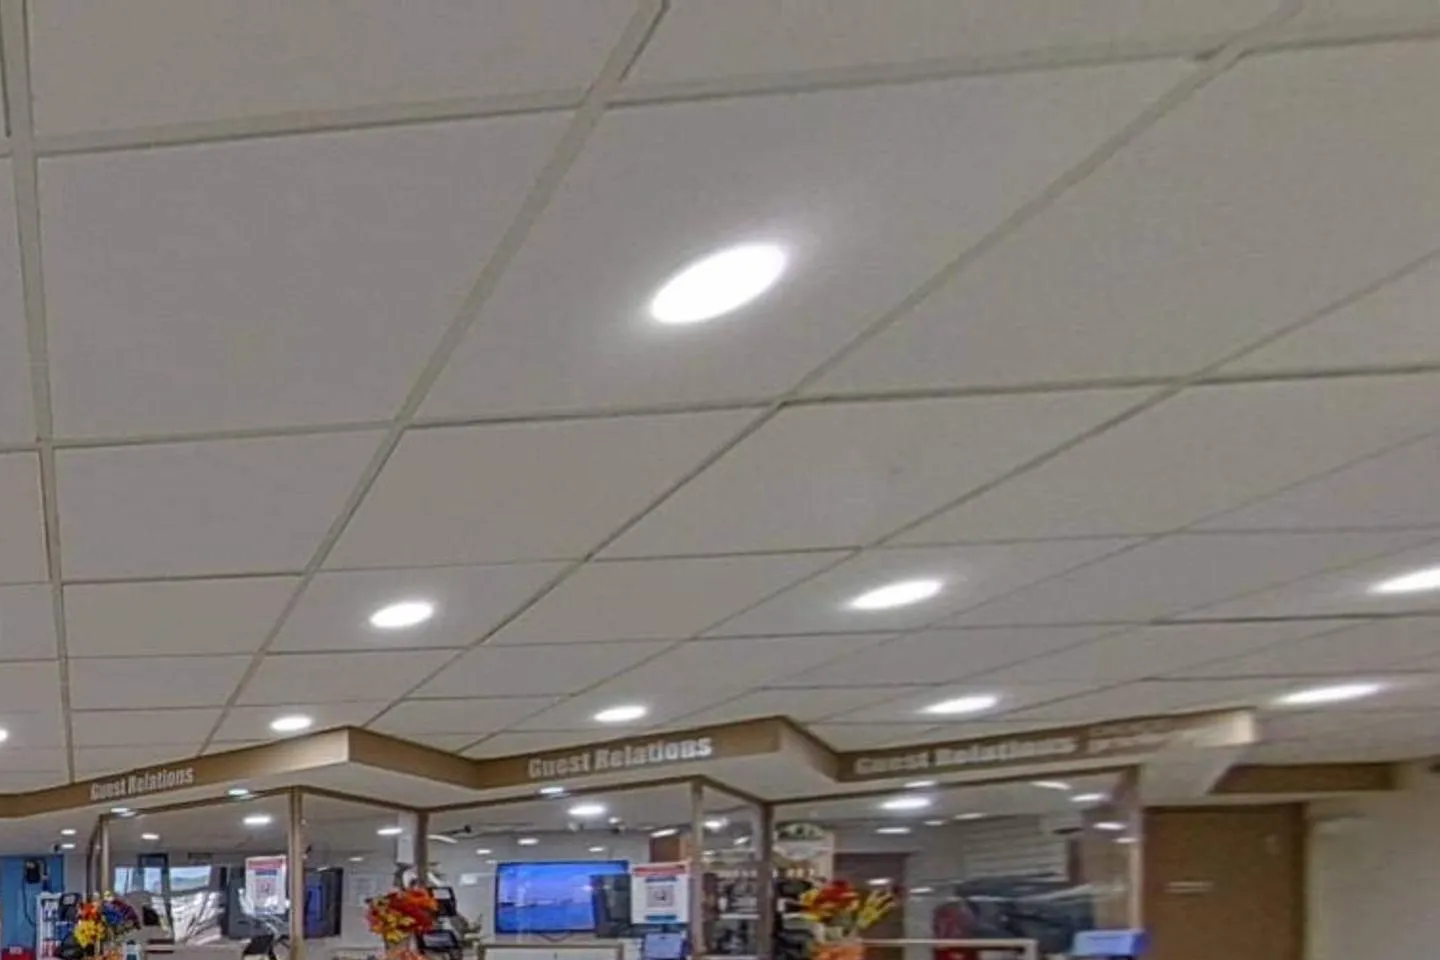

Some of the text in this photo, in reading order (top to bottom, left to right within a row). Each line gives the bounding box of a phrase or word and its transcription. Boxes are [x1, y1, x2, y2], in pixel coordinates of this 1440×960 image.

[528, 737, 713, 778] Guest Relations
[90, 766, 194, 801] Guest Relations
